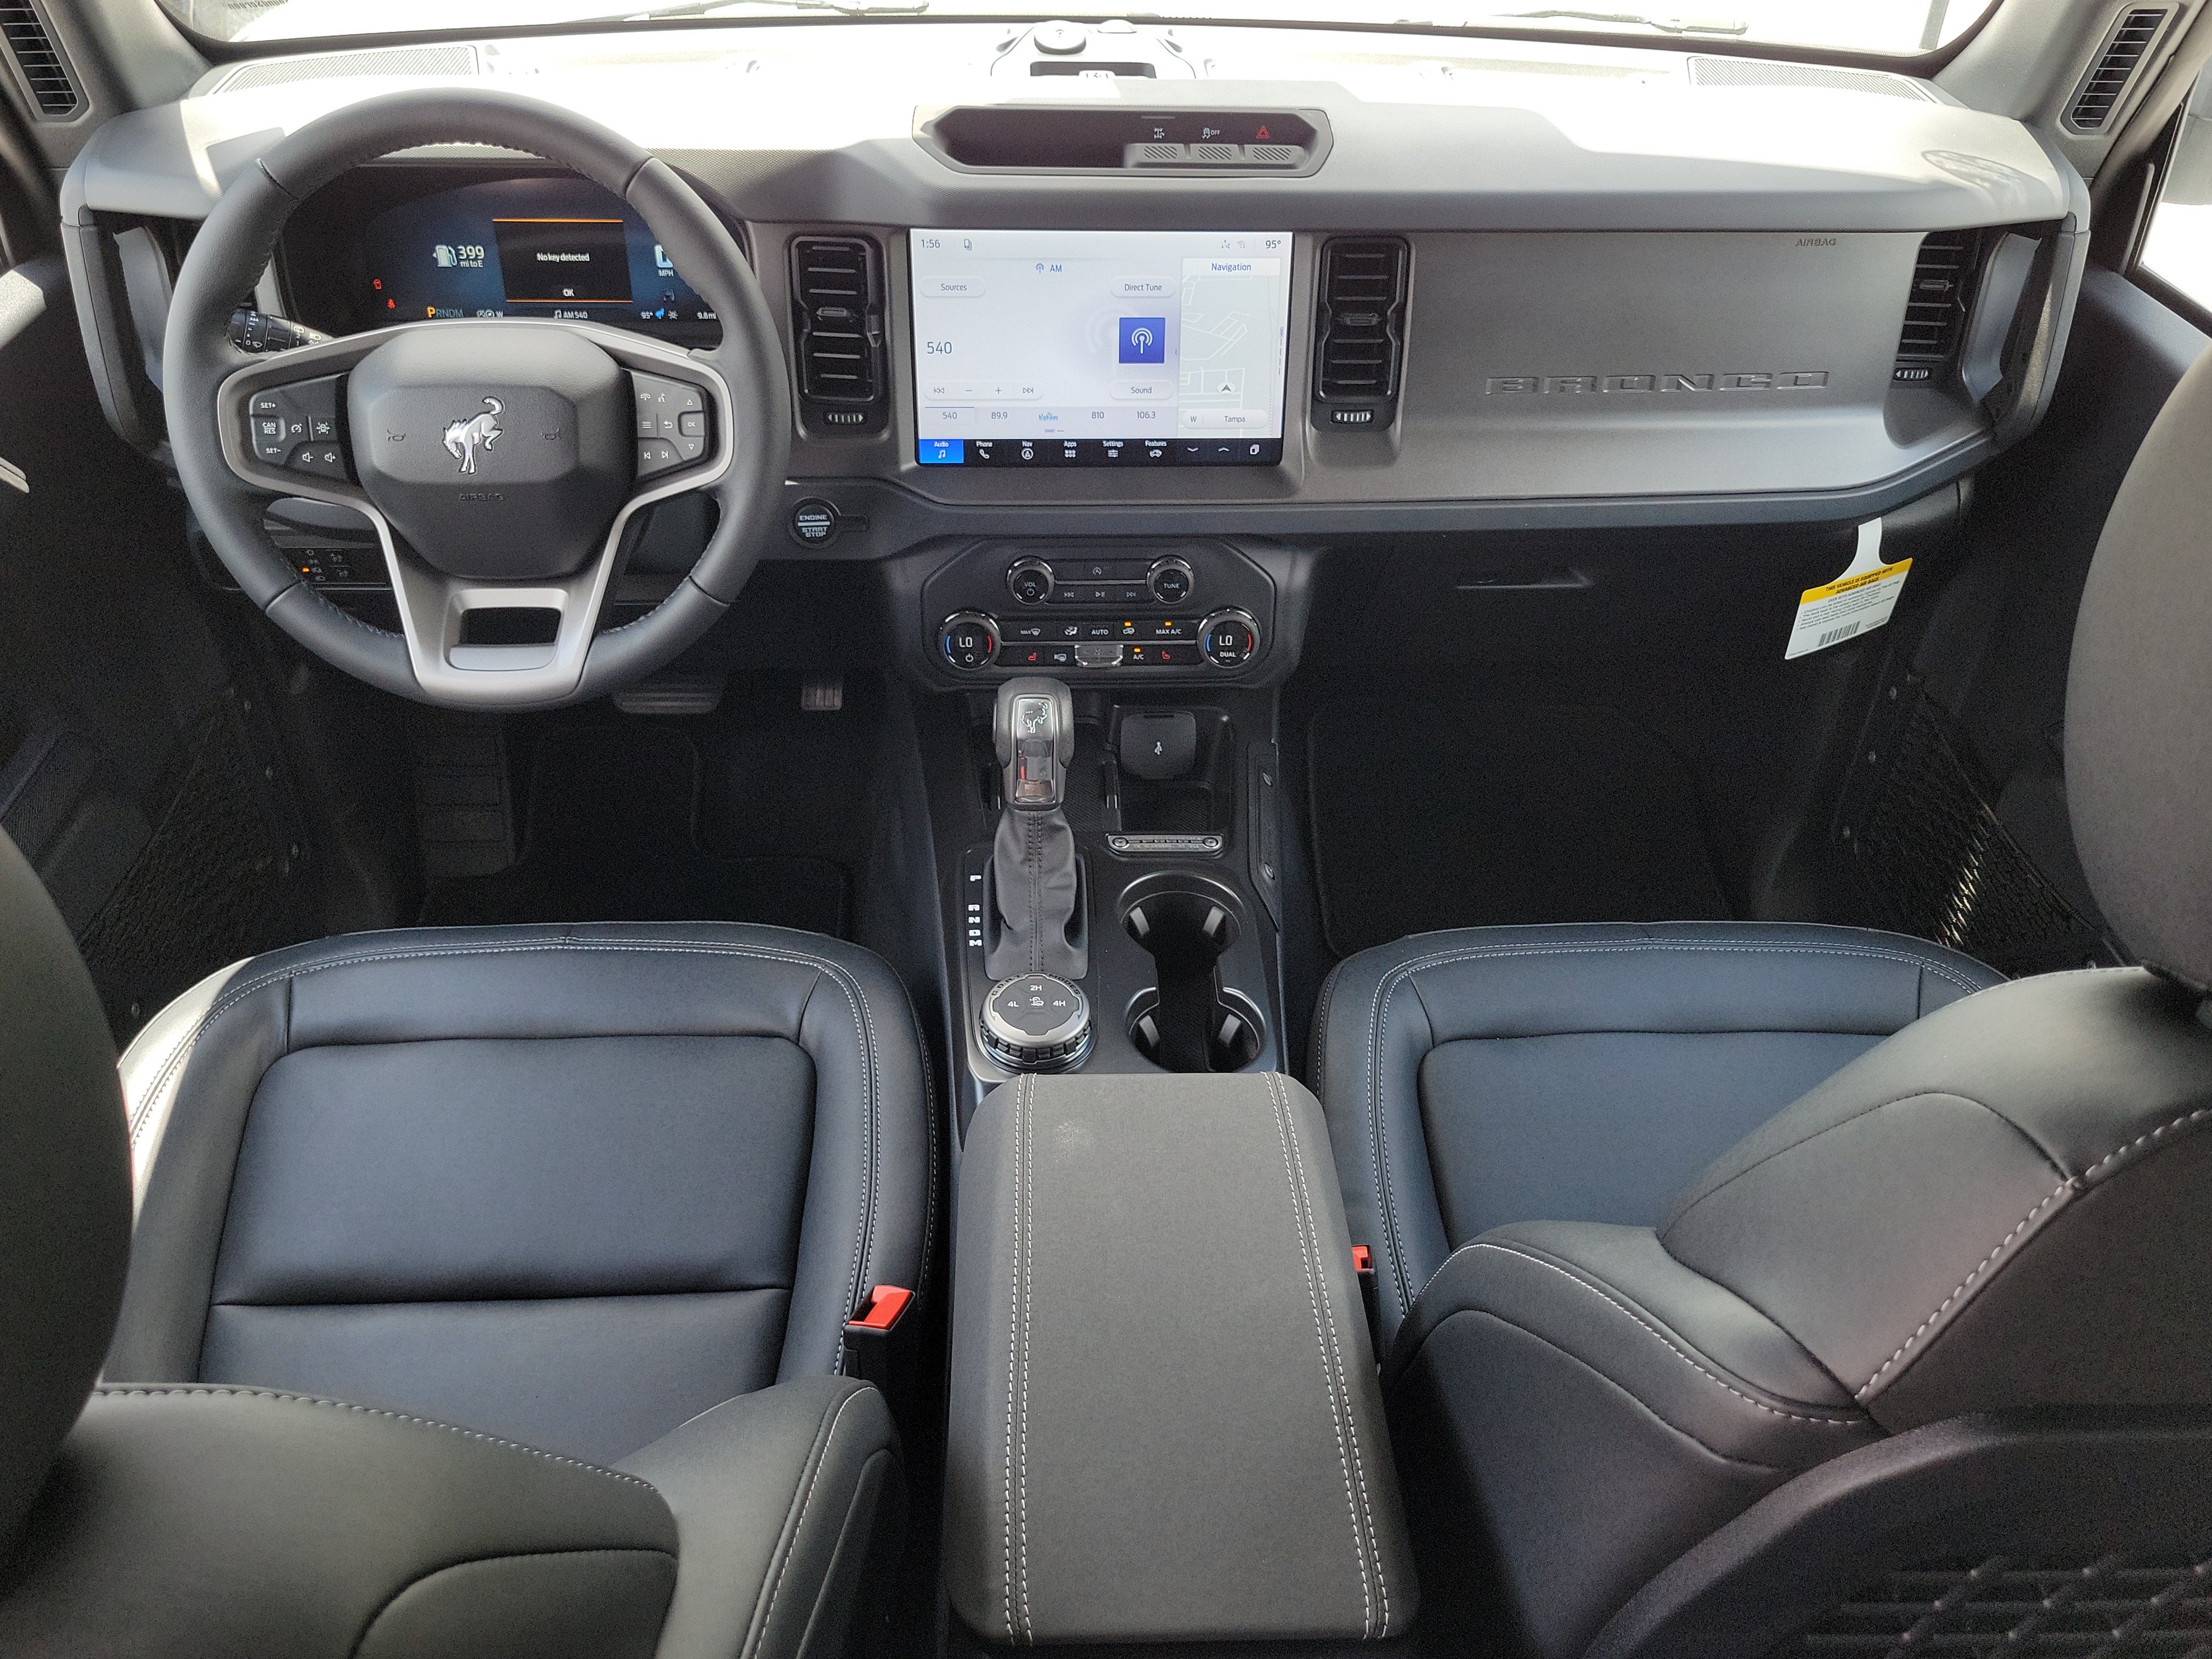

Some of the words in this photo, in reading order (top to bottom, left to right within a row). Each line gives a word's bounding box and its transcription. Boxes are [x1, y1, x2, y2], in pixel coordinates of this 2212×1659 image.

[921, 240, 940, 248] 1:56
[1266, 240, 1282, 249] 95°
[1795, 238, 1836, 246] AIRBAG
[457, 245, 484, 259] 399
[537, 253, 548, 261] No
[548, 253, 560, 263] key
[560, 253, 590, 262] detected
[1211, 263, 1251, 273] Navigation
[563, 289, 574, 297] OK
[927, 341, 952, 354] 540
[1485, 371, 1830, 394] BRONCO
[959, 637, 973, 647] LO
[1219, 635, 1233, 646] LO
[1048, 974, 1081, 995] MODES
